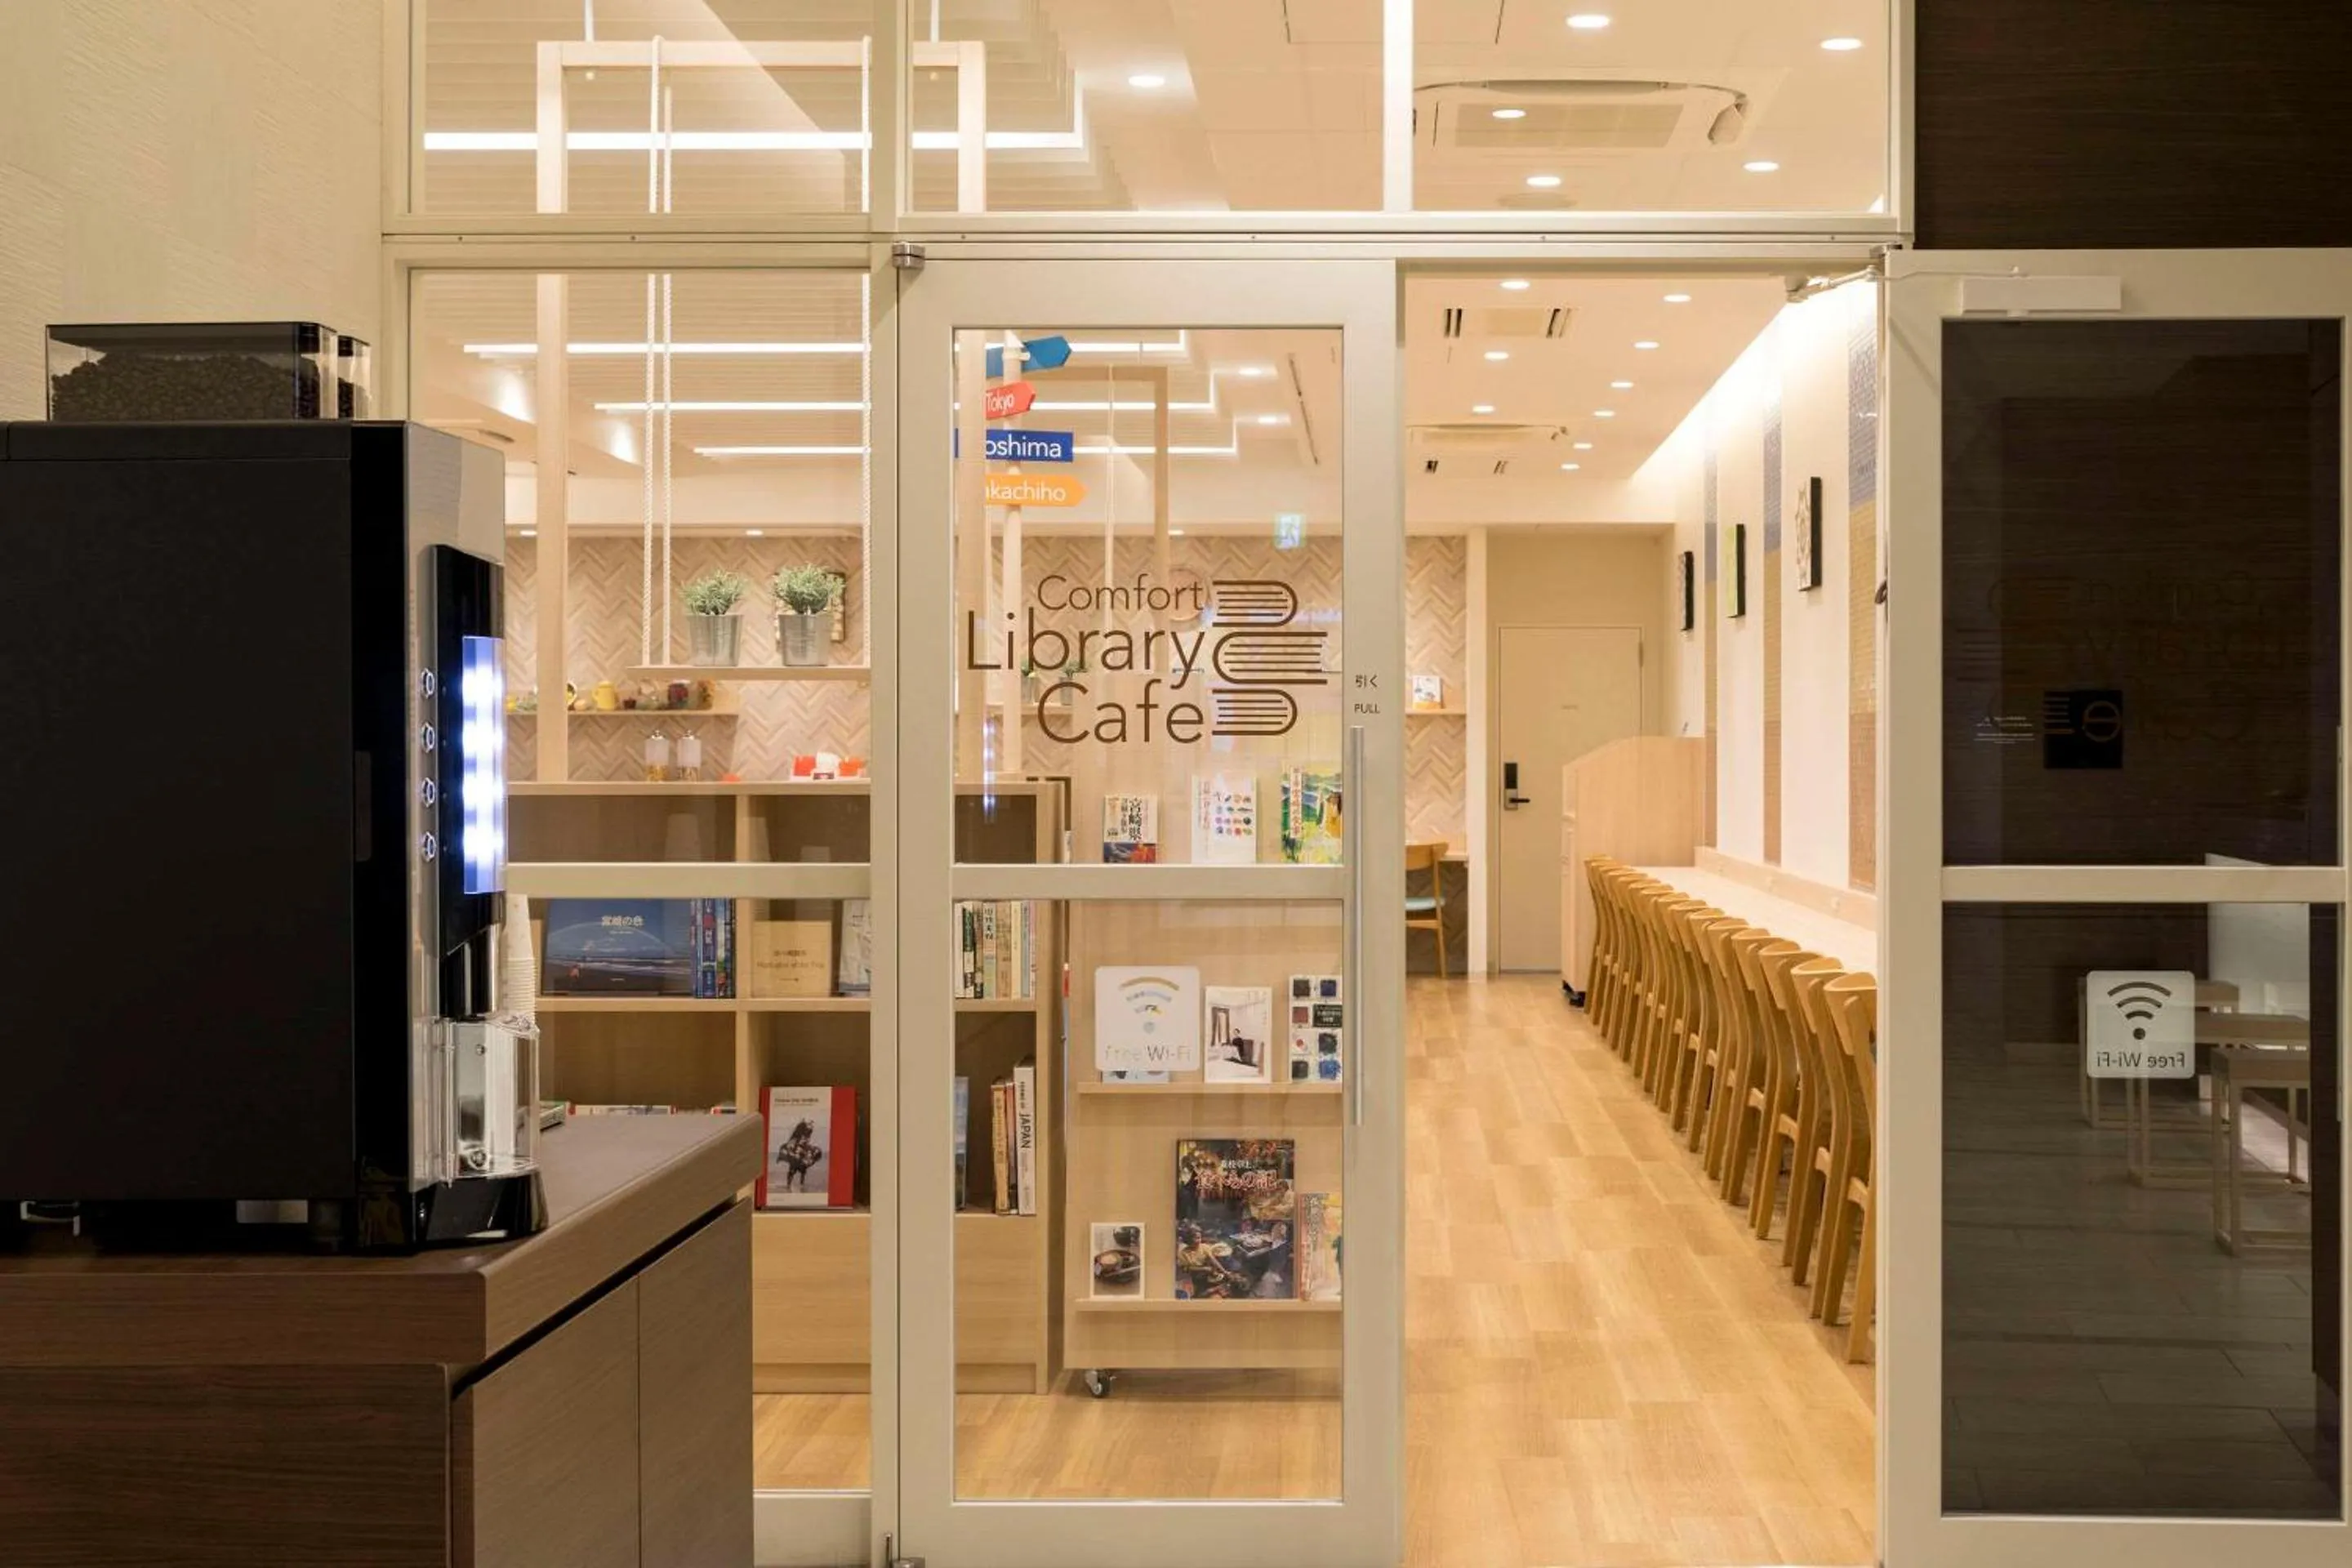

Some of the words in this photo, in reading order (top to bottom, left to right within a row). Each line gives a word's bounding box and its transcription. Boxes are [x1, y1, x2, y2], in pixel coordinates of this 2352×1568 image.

[986, 434, 1062, 458] oshima
[986, 480, 1067, 502] kachiho
[1037, 573, 1205, 611] Comfort
[968, 607, 1205, 689] Library
[1356, 674, 1378, 688] 引く
[1037, 679, 1205, 744] Cafe
[1354, 703, 1380, 714] PULL
[1018, 1114, 1031, 1148] JAPAN
